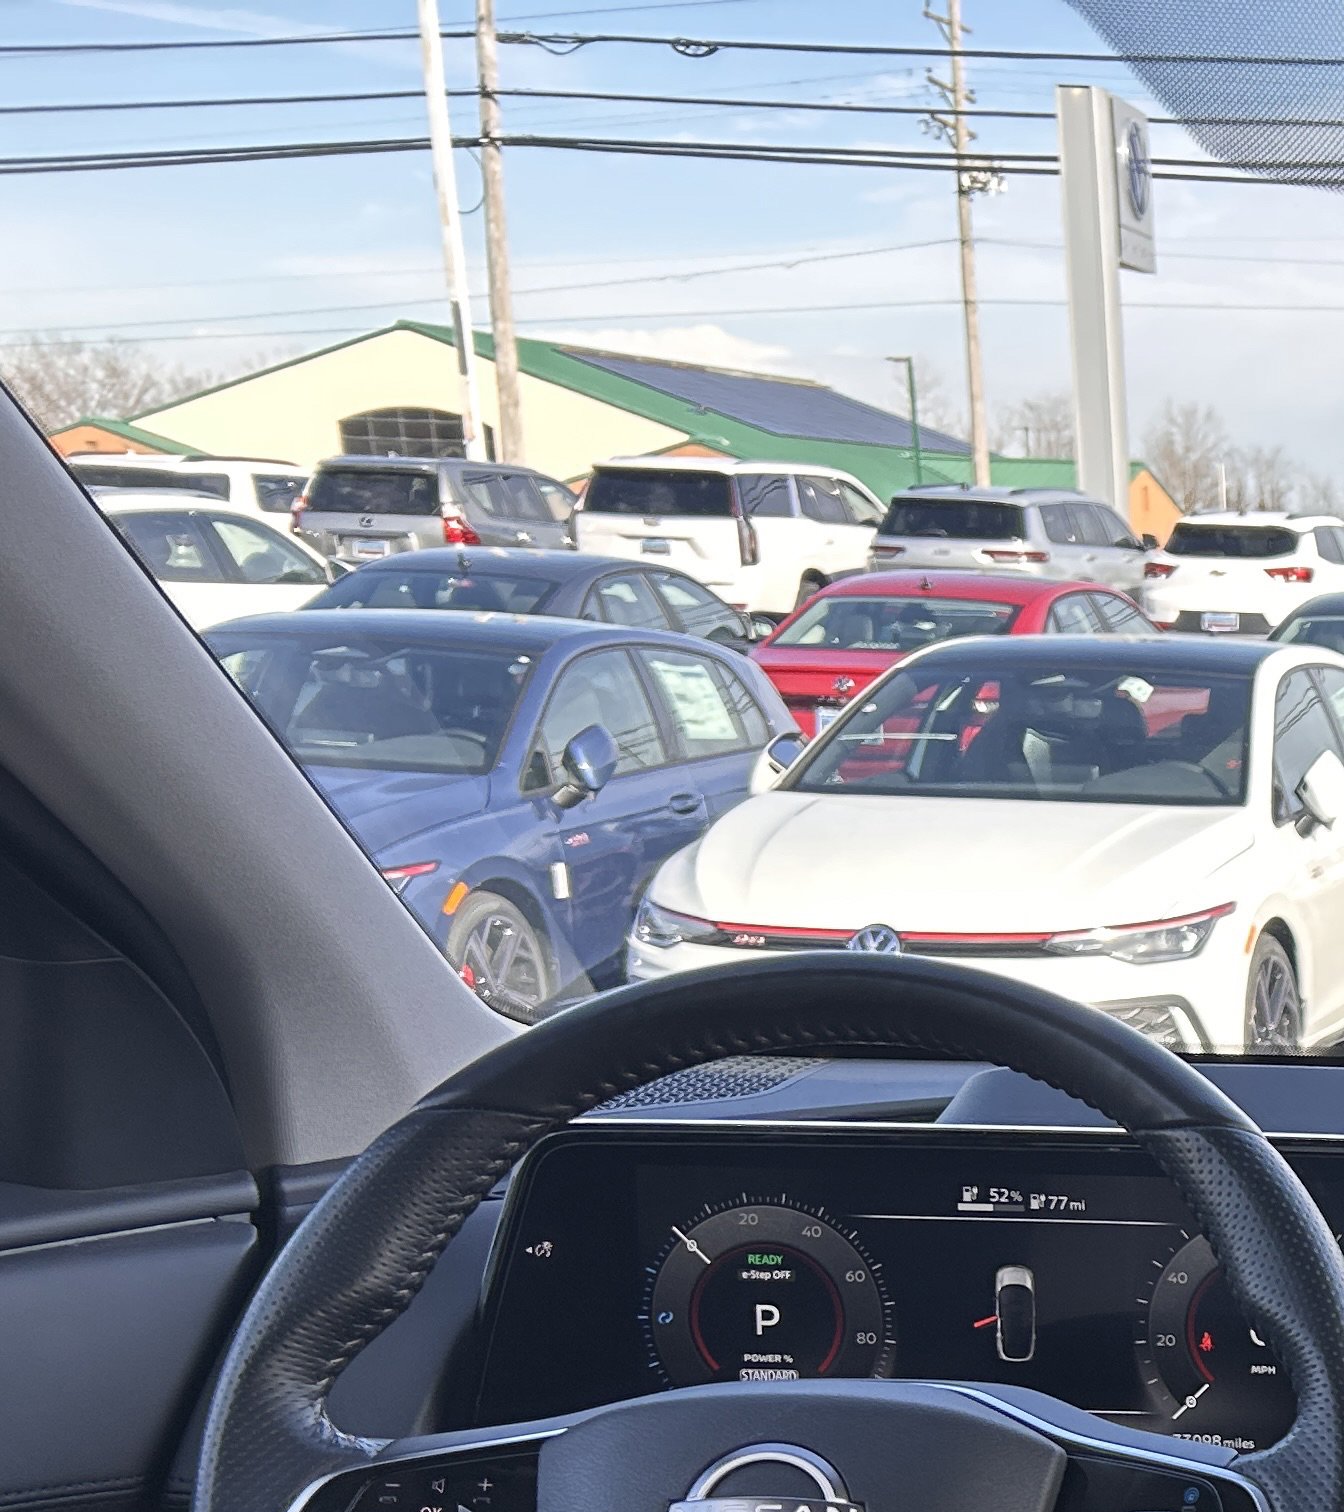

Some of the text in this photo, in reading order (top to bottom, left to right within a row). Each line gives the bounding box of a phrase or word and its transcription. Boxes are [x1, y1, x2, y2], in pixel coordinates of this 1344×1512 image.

[988, 1187, 1024, 1203] 52%
[738, 1212, 759, 1226] 20
[801, 1225, 822, 1238] 40
[747, 1254, 783, 1266] READY
[741, 1270, 792, 1281] e-Step OFF
[845, 1270, 866, 1283] 60
[1167, 1271, 1188, 1285] 40
[755, 1303, 781, 1336] P
[856, 1332, 877, 1345] 80
[1156, 1334, 1176, 1347] 20
[743, 1354, 782, 1364] POWER
[740, 1369, 797, 1382] STANDARD
[1251, 1365, 1276, 1375] MPH
